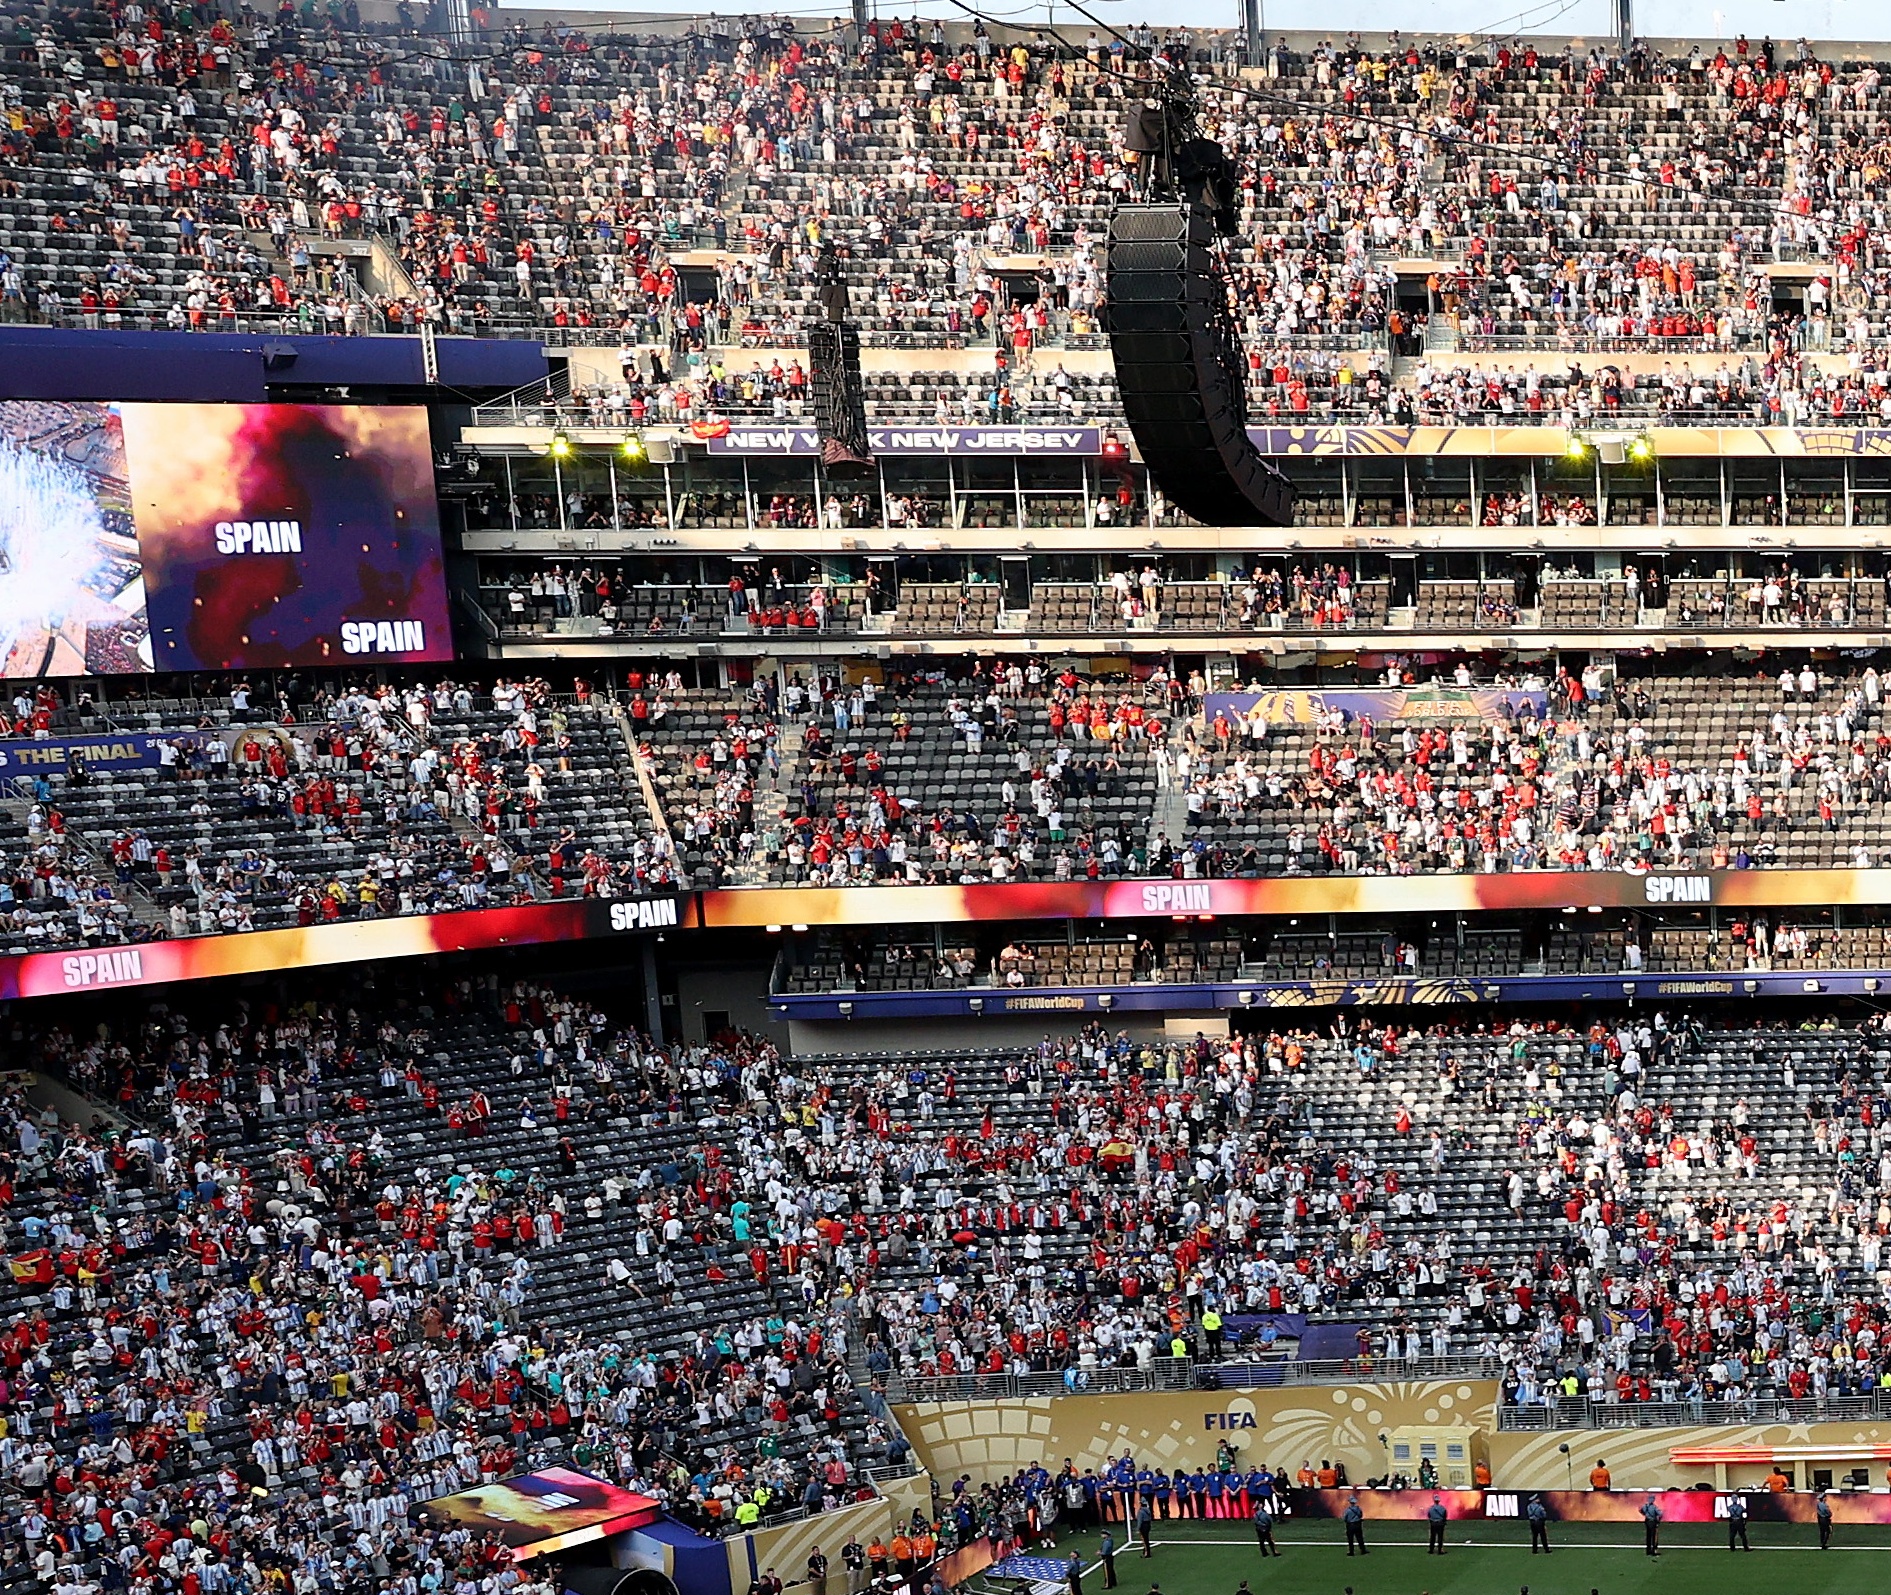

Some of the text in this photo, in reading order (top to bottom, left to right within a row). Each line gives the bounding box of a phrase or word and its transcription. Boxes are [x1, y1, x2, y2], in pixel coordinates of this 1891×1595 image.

[726, 432, 795, 450] NEW
[892, 432, 959, 449] NEW
[966, 432, 1082, 449] JERSEY
[216, 522, 301, 554] SPAIN
[342, 621, 424, 653] SPAIN
[15, 748, 65, 764] THE
[1142, 884, 1209, 911] SPAIN
[1646, 877, 1711, 902] SPAIN
[610, 900, 676, 931] SPAIN
[62, 951, 142, 987] SPAIN
[1659, 981, 1732, 994] #FIFAWorldCup
[1006, 997, 1084, 1009] #FIFAWorldCup
[1205, 1413, 1257, 1430] FIFA
[1486, 1495, 1518, 1516] AIN
